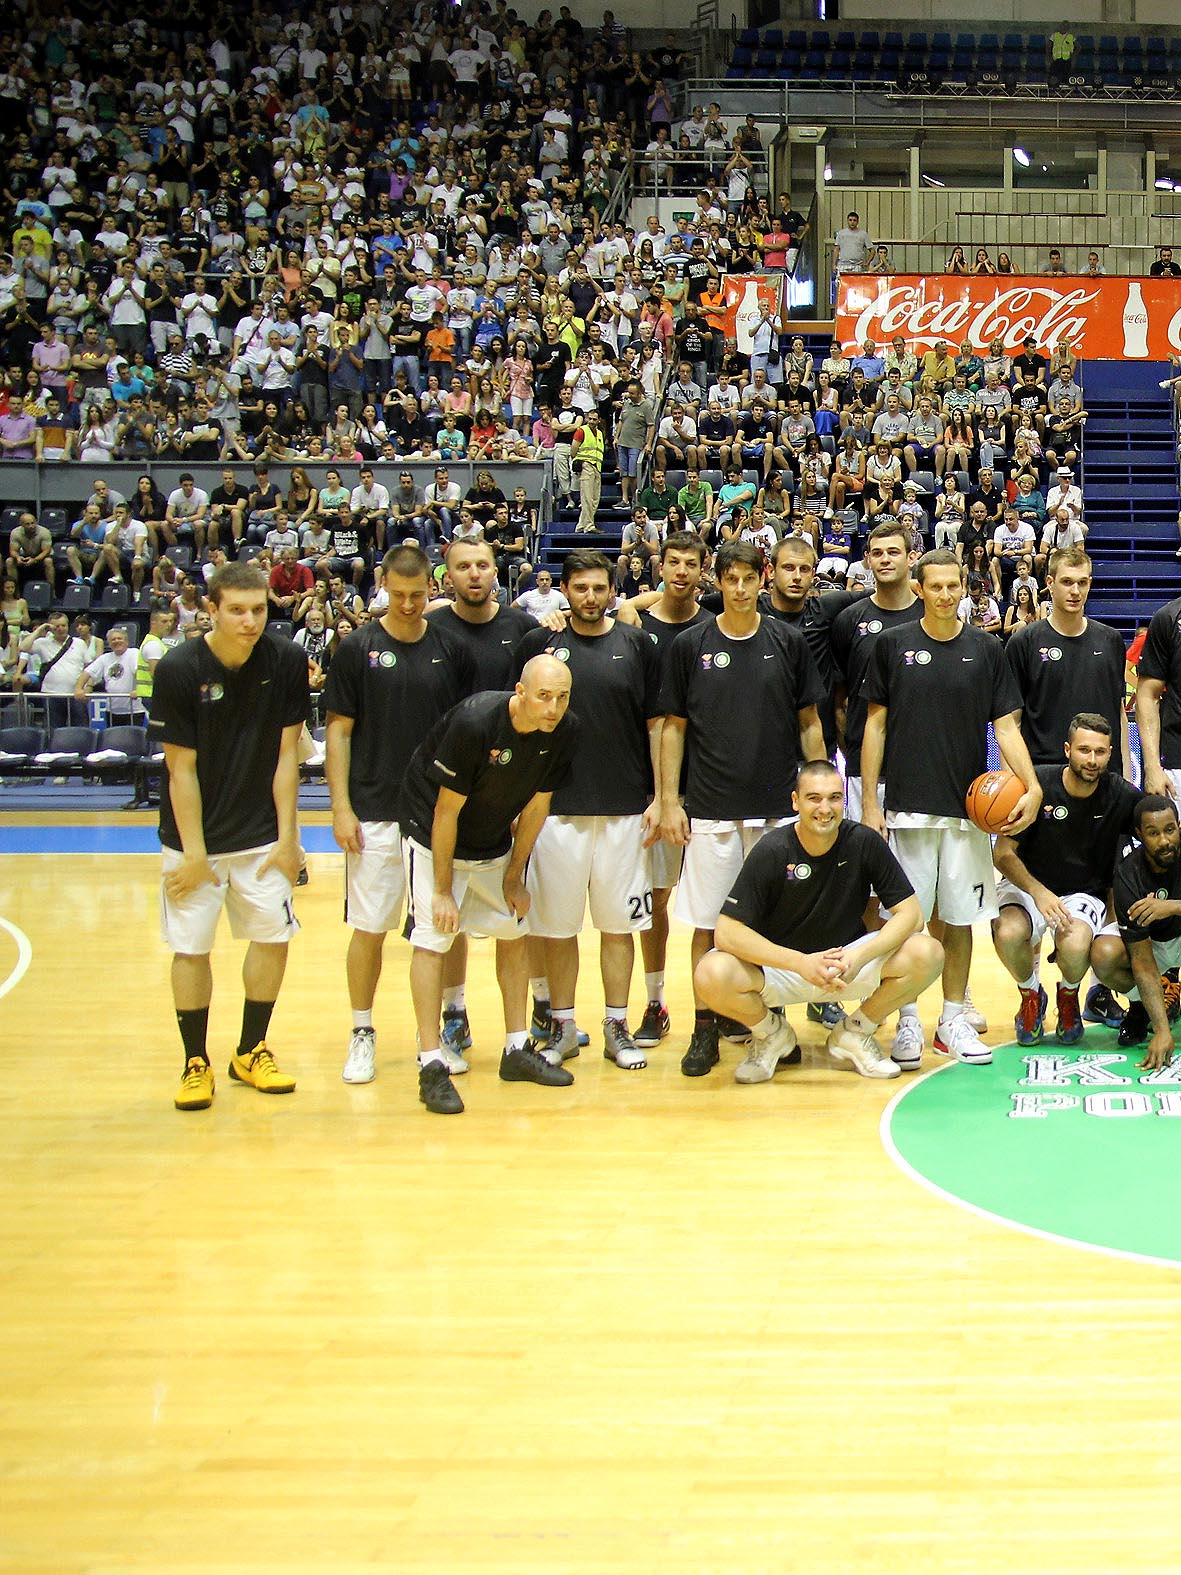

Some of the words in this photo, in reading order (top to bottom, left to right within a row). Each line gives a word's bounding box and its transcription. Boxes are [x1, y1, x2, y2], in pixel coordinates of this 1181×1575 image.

[842, 285, 1101, 352] Coca-Cola
[629, 892, 653, 920] 20
[973, 883, 985, 911] 7
[1077, 902, 1099, 926] 10
